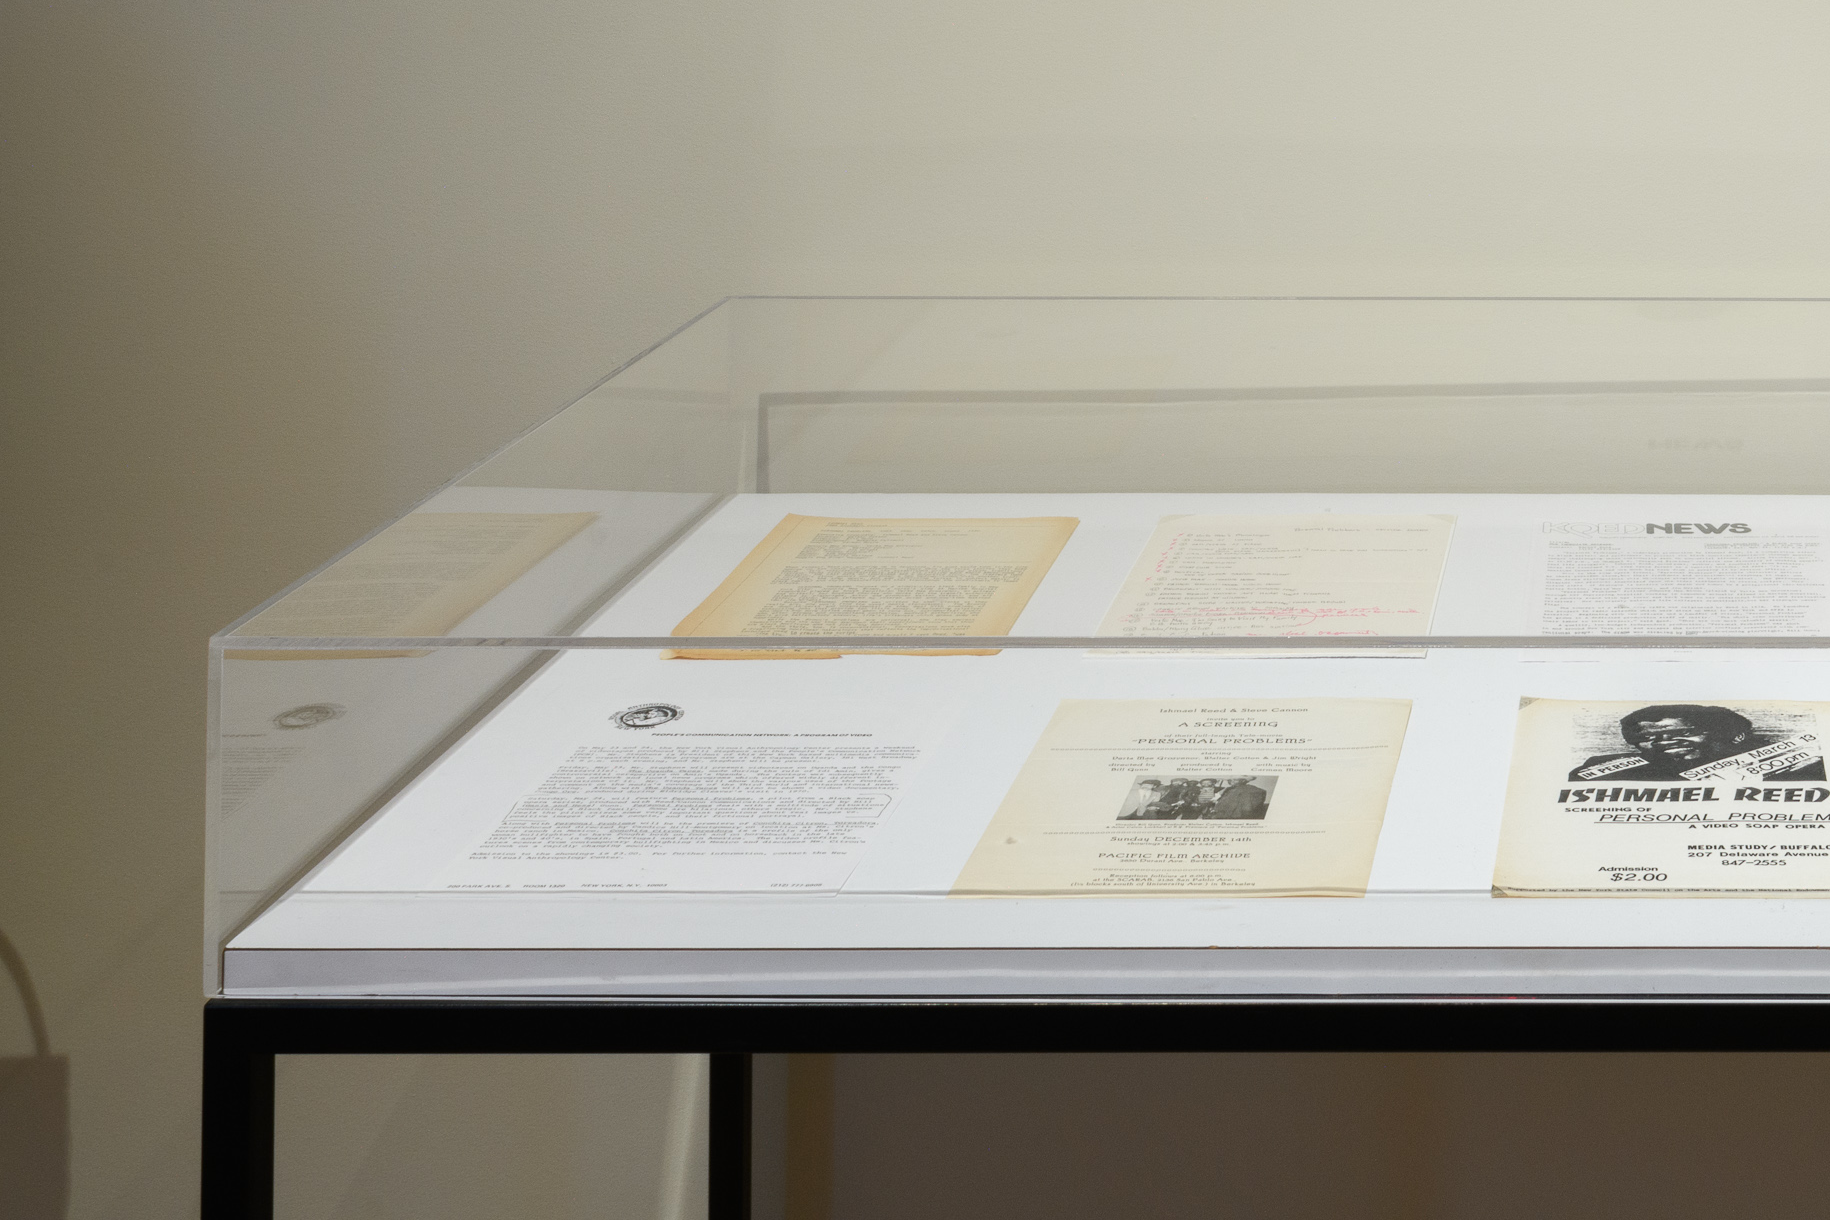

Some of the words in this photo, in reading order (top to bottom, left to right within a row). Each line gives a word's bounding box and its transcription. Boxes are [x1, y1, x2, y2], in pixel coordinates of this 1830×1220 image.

[1646, 523, 1752, 534] NEWS
[1682, 757, 1745, 778] Sunday,
[1748, 740, 1796, 759] March
[1798, 734, 1817, 742] 13
[1745, 759, 1784, 774] 8:00
[1785, 752, 1809, 764] pm
[1599, 758, 1645, 774] PERSON
[1557, 787, 1720, 803] ISHMAEL
[1733, 786, 1830, 802] REED
[1598, 813, 1715, 822] PERSONAL
[1610, 872, 1668, 882] $2.00
